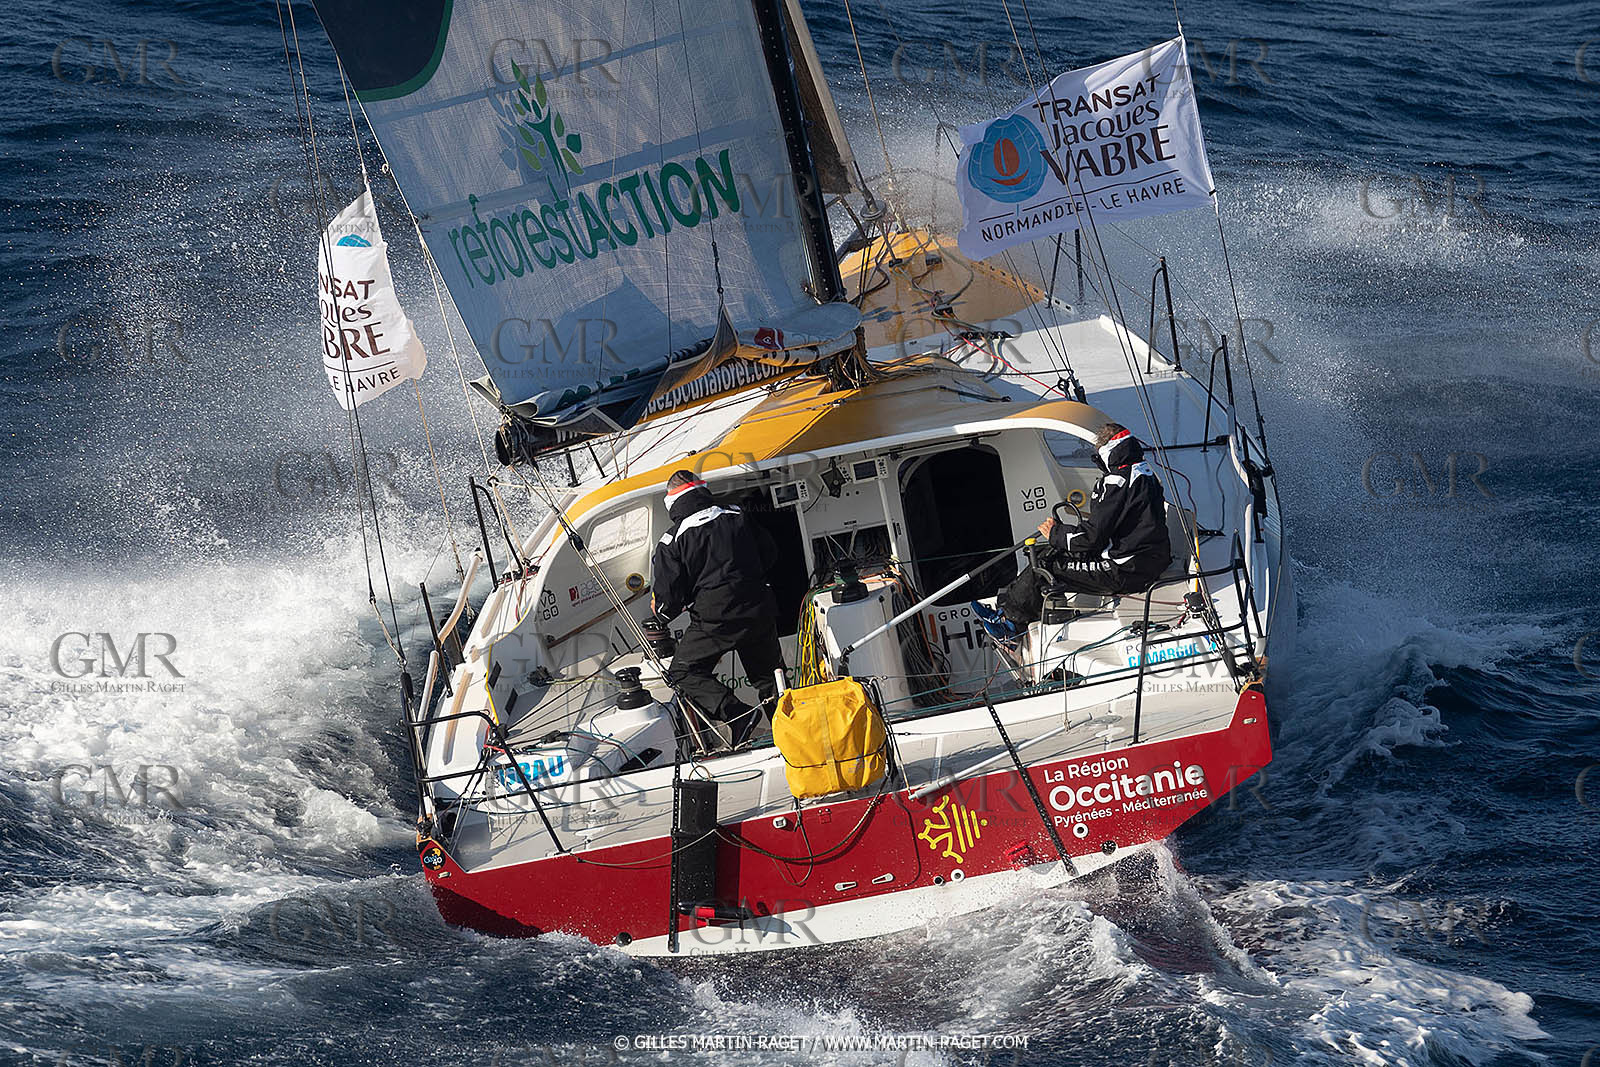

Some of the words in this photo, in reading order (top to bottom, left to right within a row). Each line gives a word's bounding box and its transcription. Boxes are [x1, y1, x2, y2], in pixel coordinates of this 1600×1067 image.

[1032, 74, 1159, 122] TRANSAT
[1040, 125, 1176, 185] VABRE
[448, 149, 740, 288] reforestACTION
[981, 202, 1084, 242] NORMANDIE
[1100, 193, 1122, 210] LE
[1127, 177, 1186, 204] HAVRE
[323, 321, 391, 360] BRE
[346, 366, 401, 392] HAVRE
[1021, 487, 1045, 499] VO
[1044, 769, 1064, 784] La
[1068, 756, 1129, 779] Région
[1049, 760, 1204, 812] Occitanie
[1054, 806, 1113, 828] Pyrénées
[1123, 788, 1208, 814] Méditerranée
